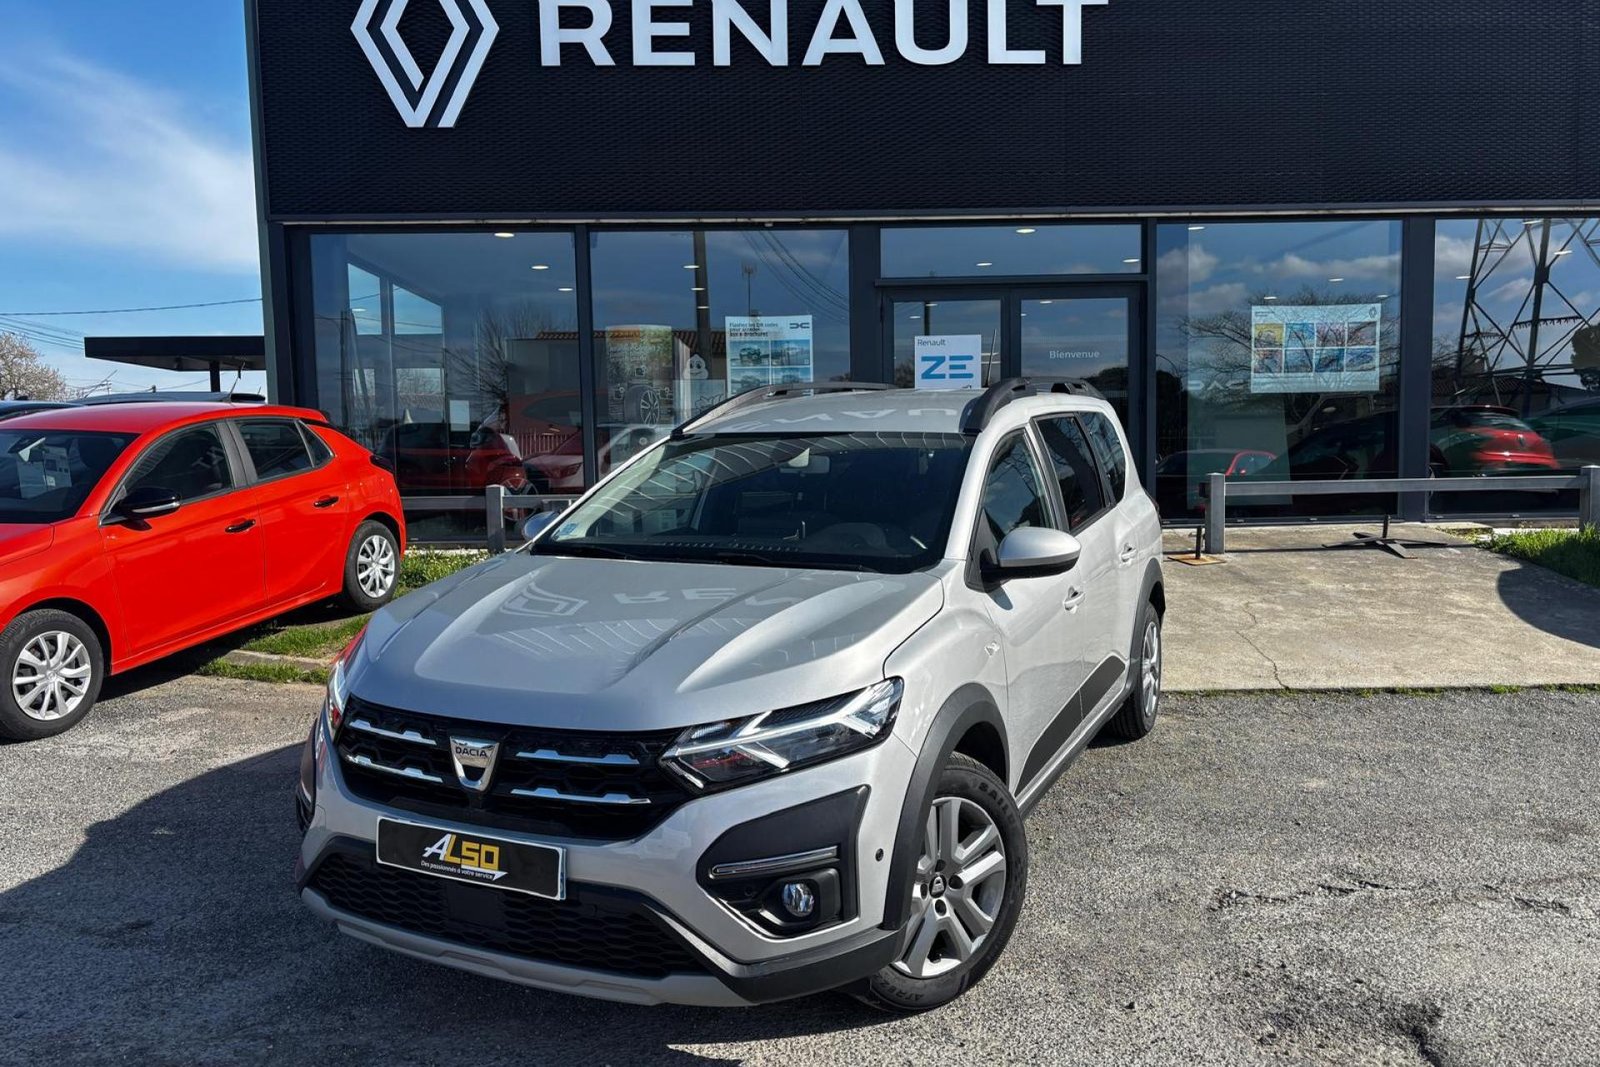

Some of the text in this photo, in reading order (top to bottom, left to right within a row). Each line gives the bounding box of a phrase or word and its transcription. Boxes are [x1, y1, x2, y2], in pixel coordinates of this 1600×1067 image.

[538, 0, 1109, 67] RENAULT
[917, 338, 946, 347] Renault
[1049, 350, 1100, 359] Bienvenue
[921, 355, 974, 379] ZE
[455, 746, 488, 758] DACIA
[422, 833, 500, 871] ALSO
[420, 860, 430, 868] Des
[461, 869, 475, 877] votre
[475, 871, 493, 879] service
